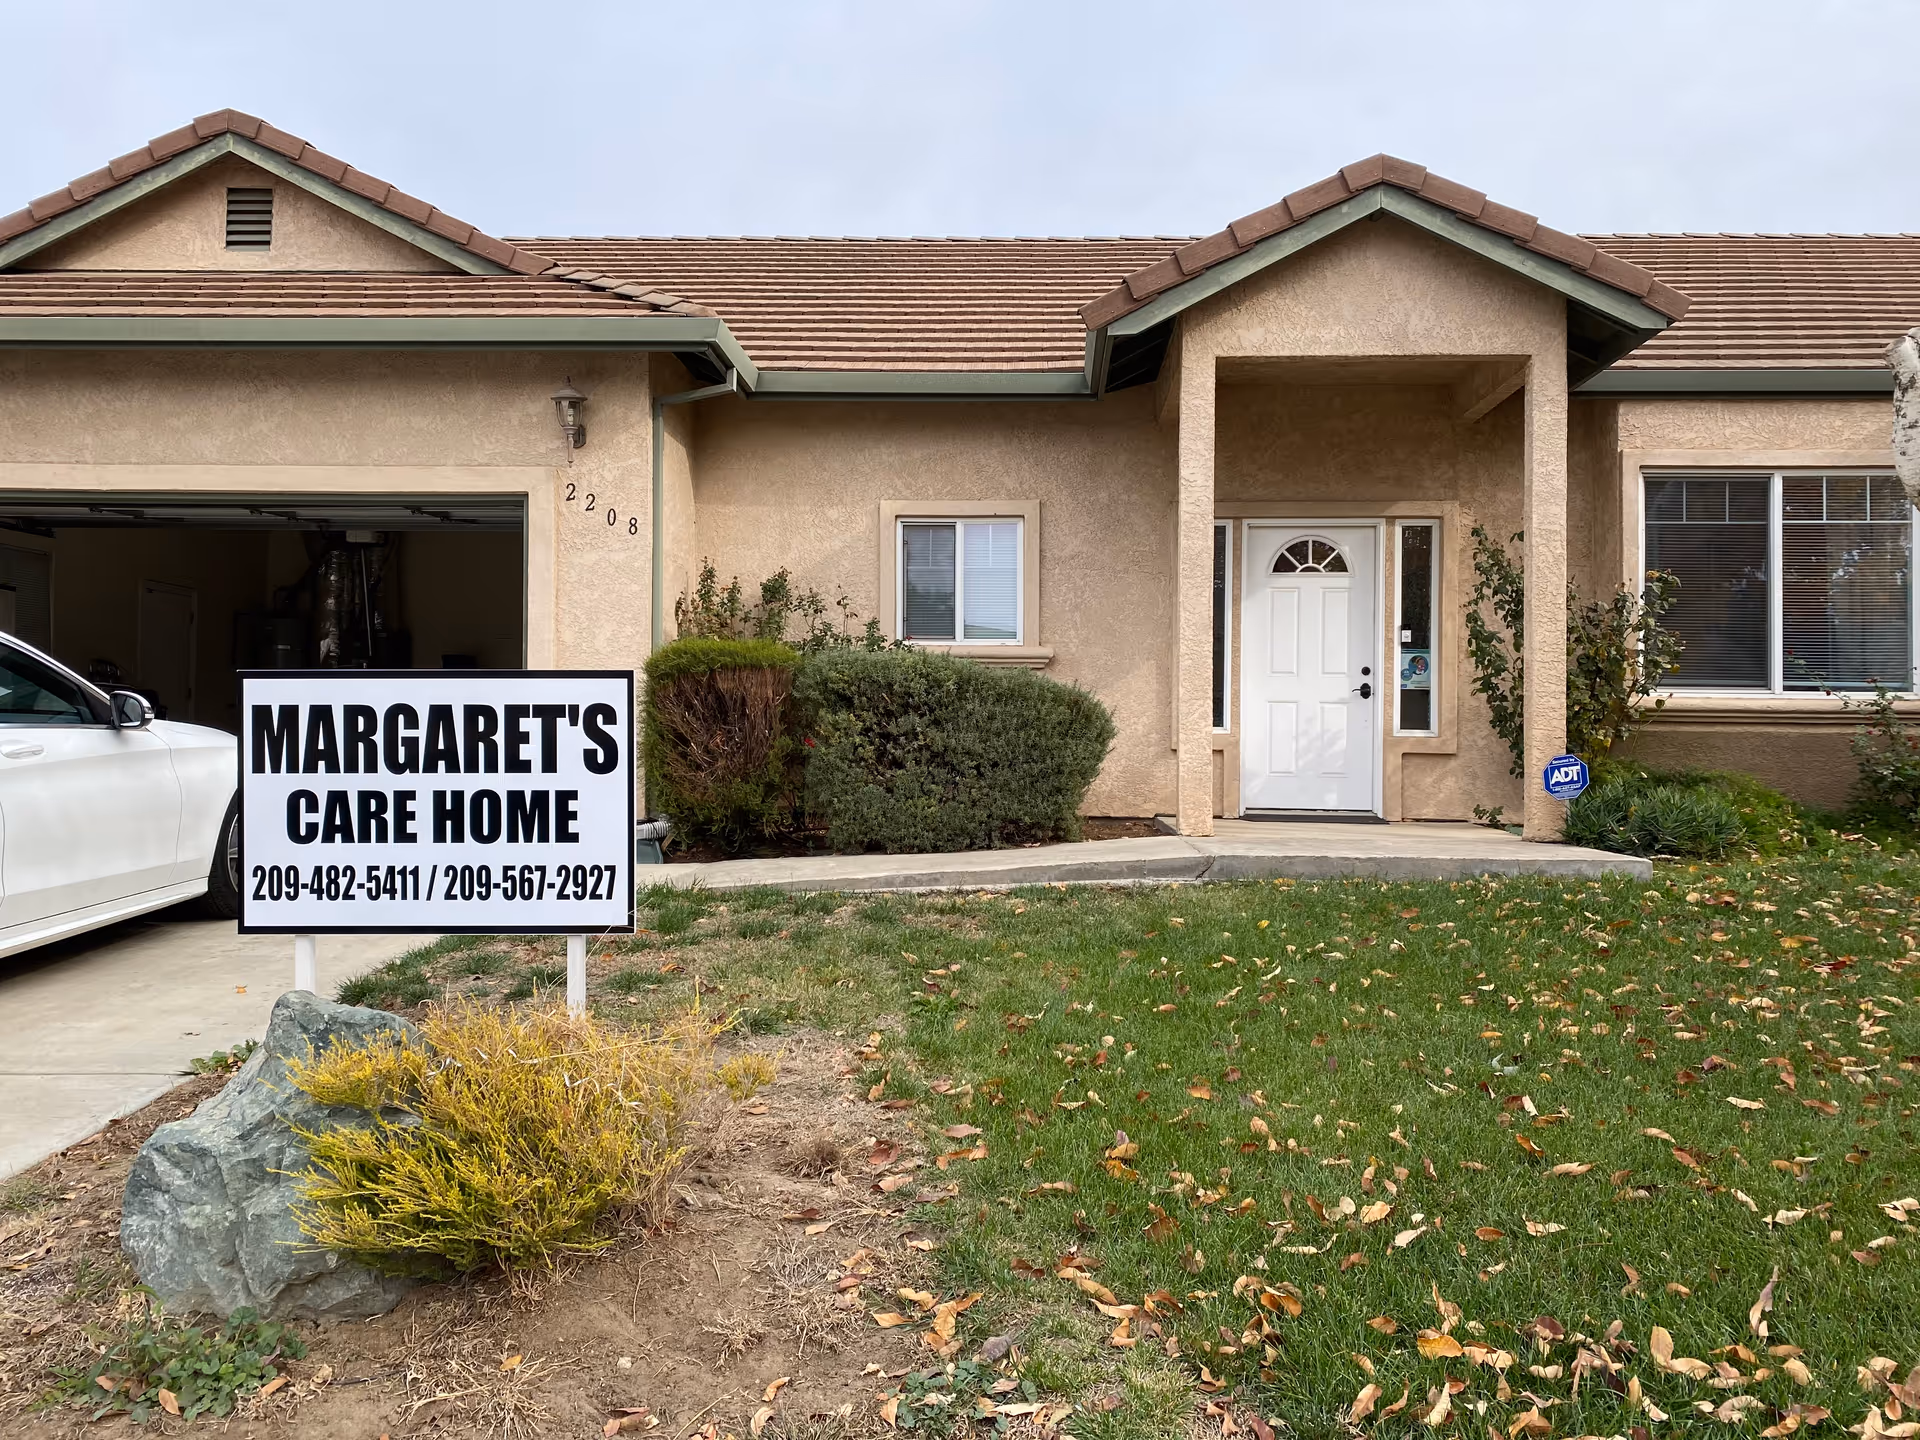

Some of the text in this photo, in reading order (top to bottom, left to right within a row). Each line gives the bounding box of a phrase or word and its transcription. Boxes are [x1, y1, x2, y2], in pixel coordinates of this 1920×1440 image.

[565, 482, 638, 535] 2208
[251, 702, 619, 775] MARGARET'S
[1551, 765, 1580, 784] ADT
[286, 788, 580, 845] CARE HOME
[252, 864, 617, 902] 209-482-5411 / 209-567-2927
